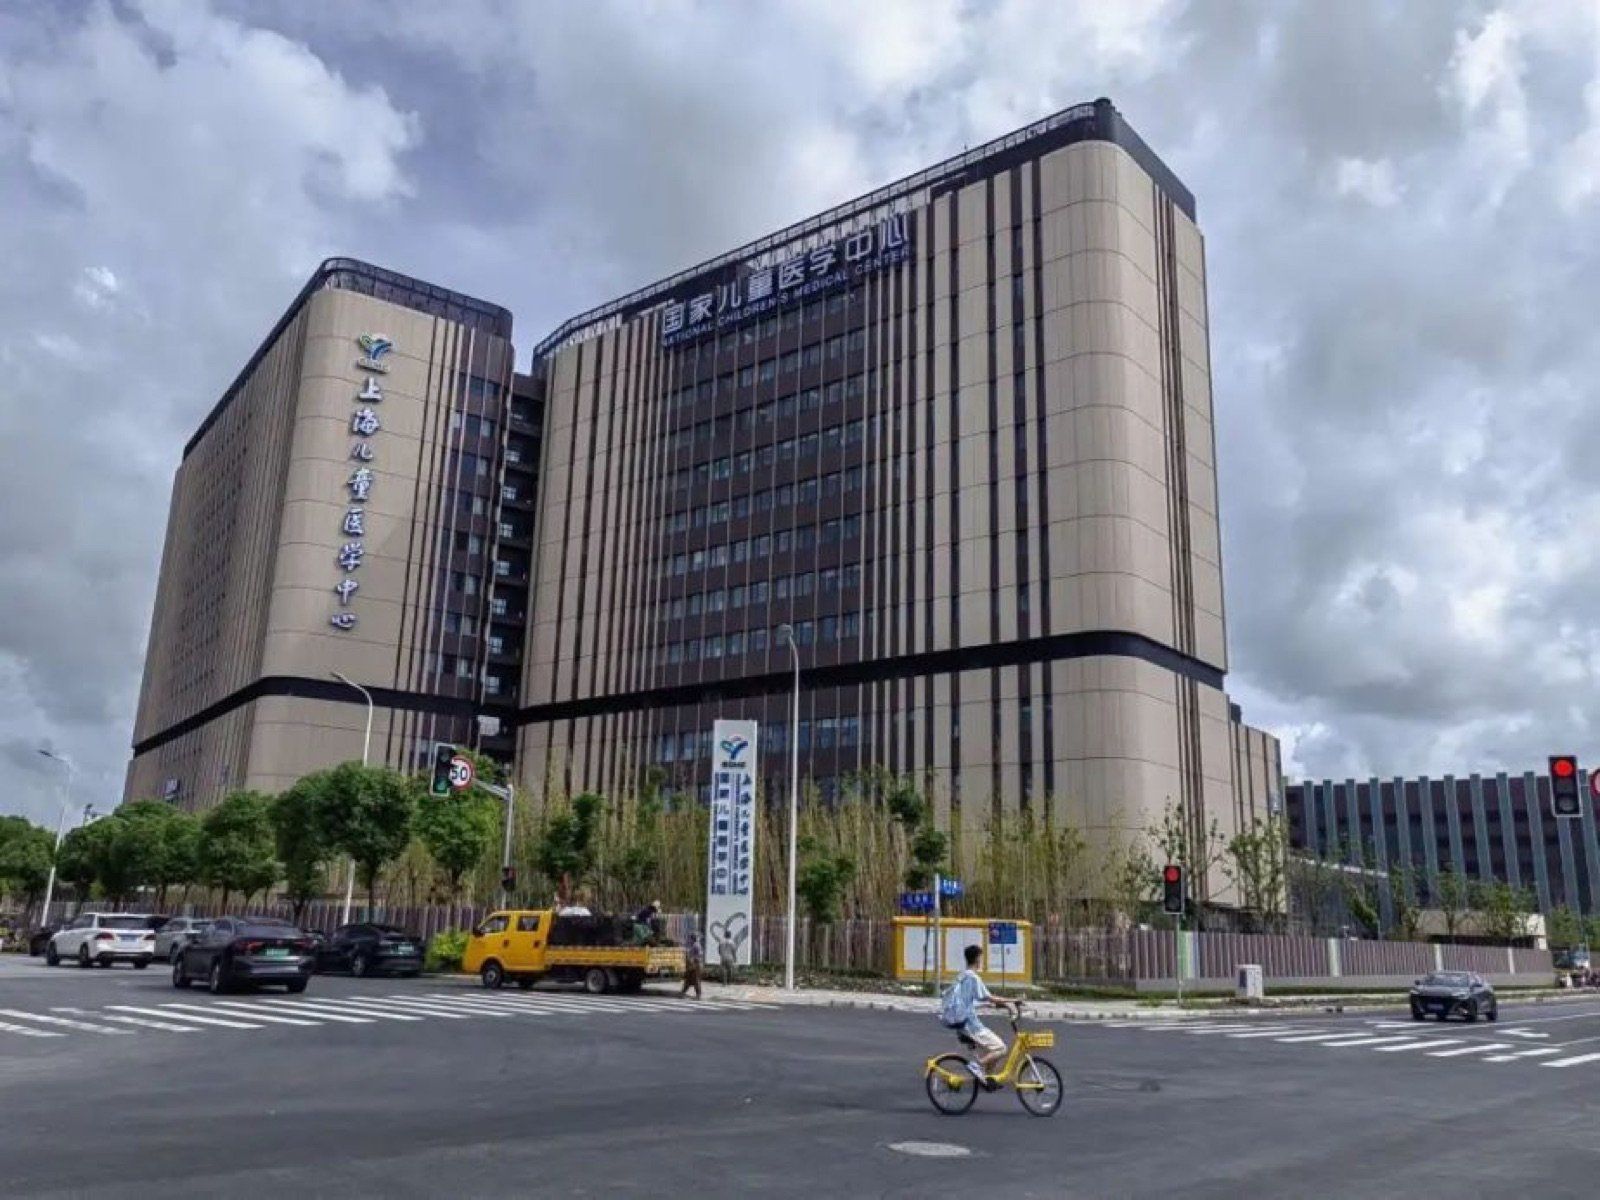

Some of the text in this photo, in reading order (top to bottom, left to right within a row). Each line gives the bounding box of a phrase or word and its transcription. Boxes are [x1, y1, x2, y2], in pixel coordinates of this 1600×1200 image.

[662, 213, 909, 334] 国家儿童医学中心
[793, 272, 848, 297] MEDICAL
[855, 247, 910, 276] CENTER
[331, 376, 381, 630] 上海儿童医学中心
